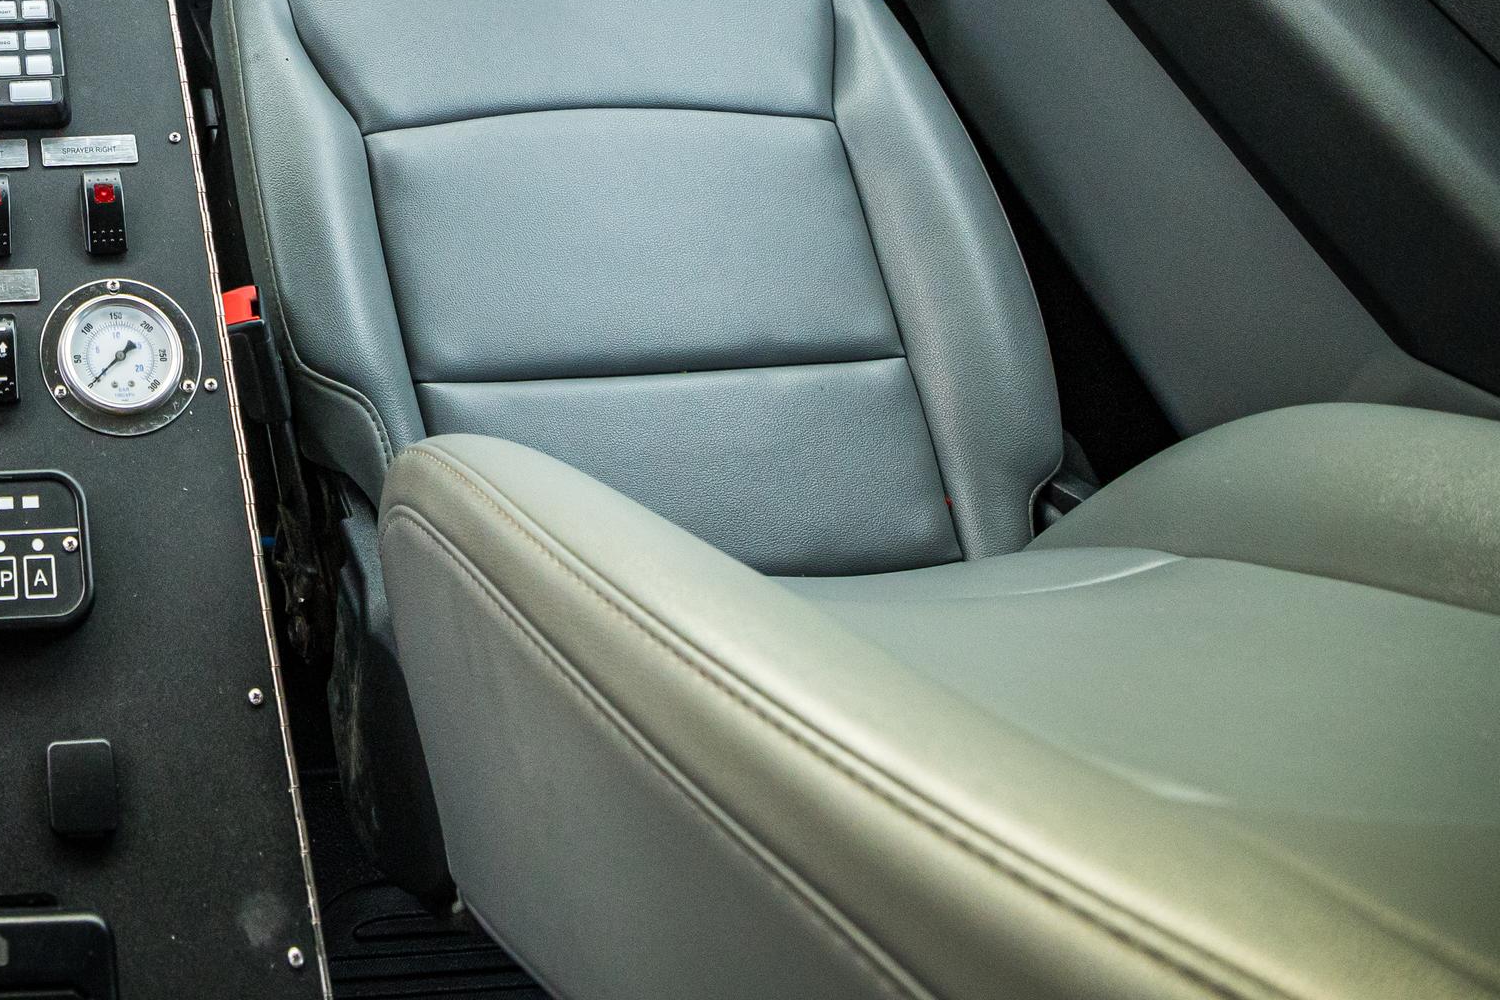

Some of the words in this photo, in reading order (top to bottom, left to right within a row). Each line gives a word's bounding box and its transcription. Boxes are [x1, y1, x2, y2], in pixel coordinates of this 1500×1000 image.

[62, 147, 94, 155] SPRAYER
[95, 145, 117, 153] RIGHT
[109, 311, 123, 320] 150
[82, 323, 93, 335] 100
[140, 321, 153, 333] 200
[74, 355, 82, 363] 50
[159, 349, 167, 362] 250
[135, 364, 144, 372] 20
[147, 379, 161, 392] 300
[33, 569, 48, 587] A
